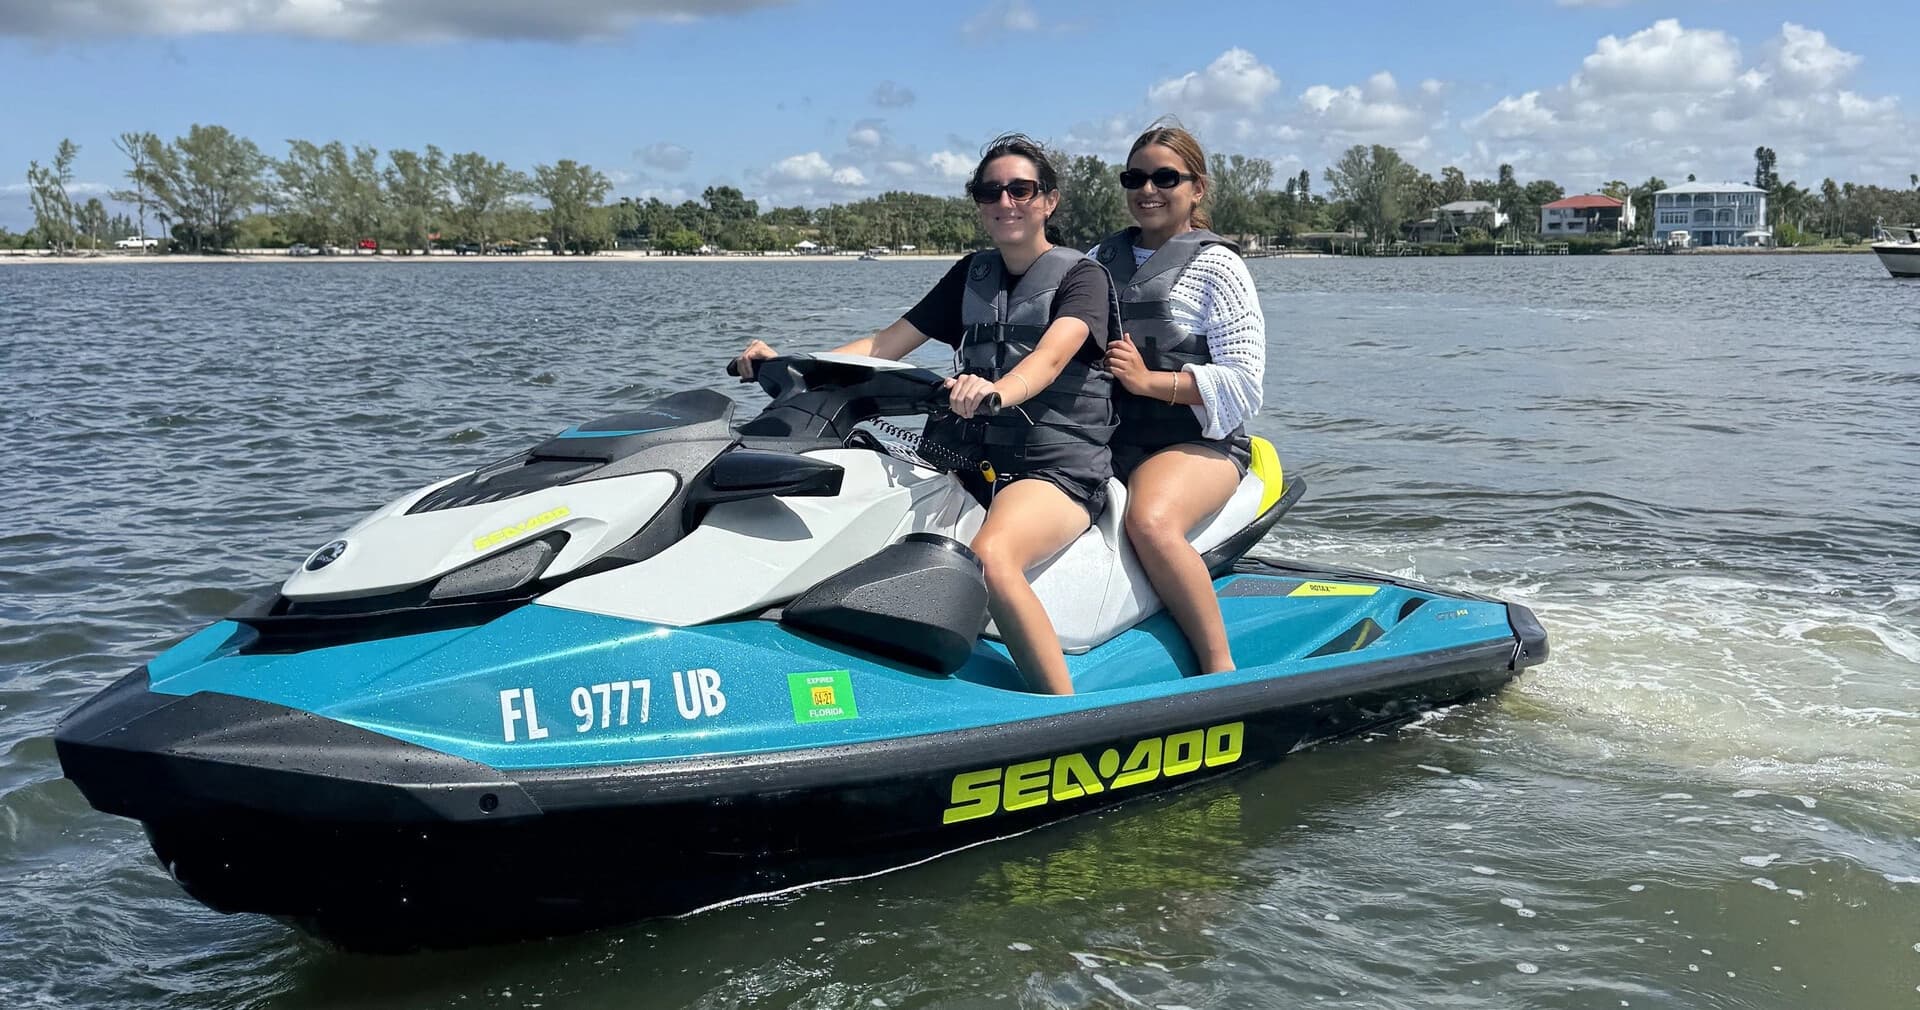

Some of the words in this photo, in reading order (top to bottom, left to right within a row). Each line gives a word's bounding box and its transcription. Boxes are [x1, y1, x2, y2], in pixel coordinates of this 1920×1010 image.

[500, 688, 549, 742] FL
[570, 679, 651, 733] 9777
[672, 668, 727, 720] UB
[809, 708, 844, 718] FLORIDA
